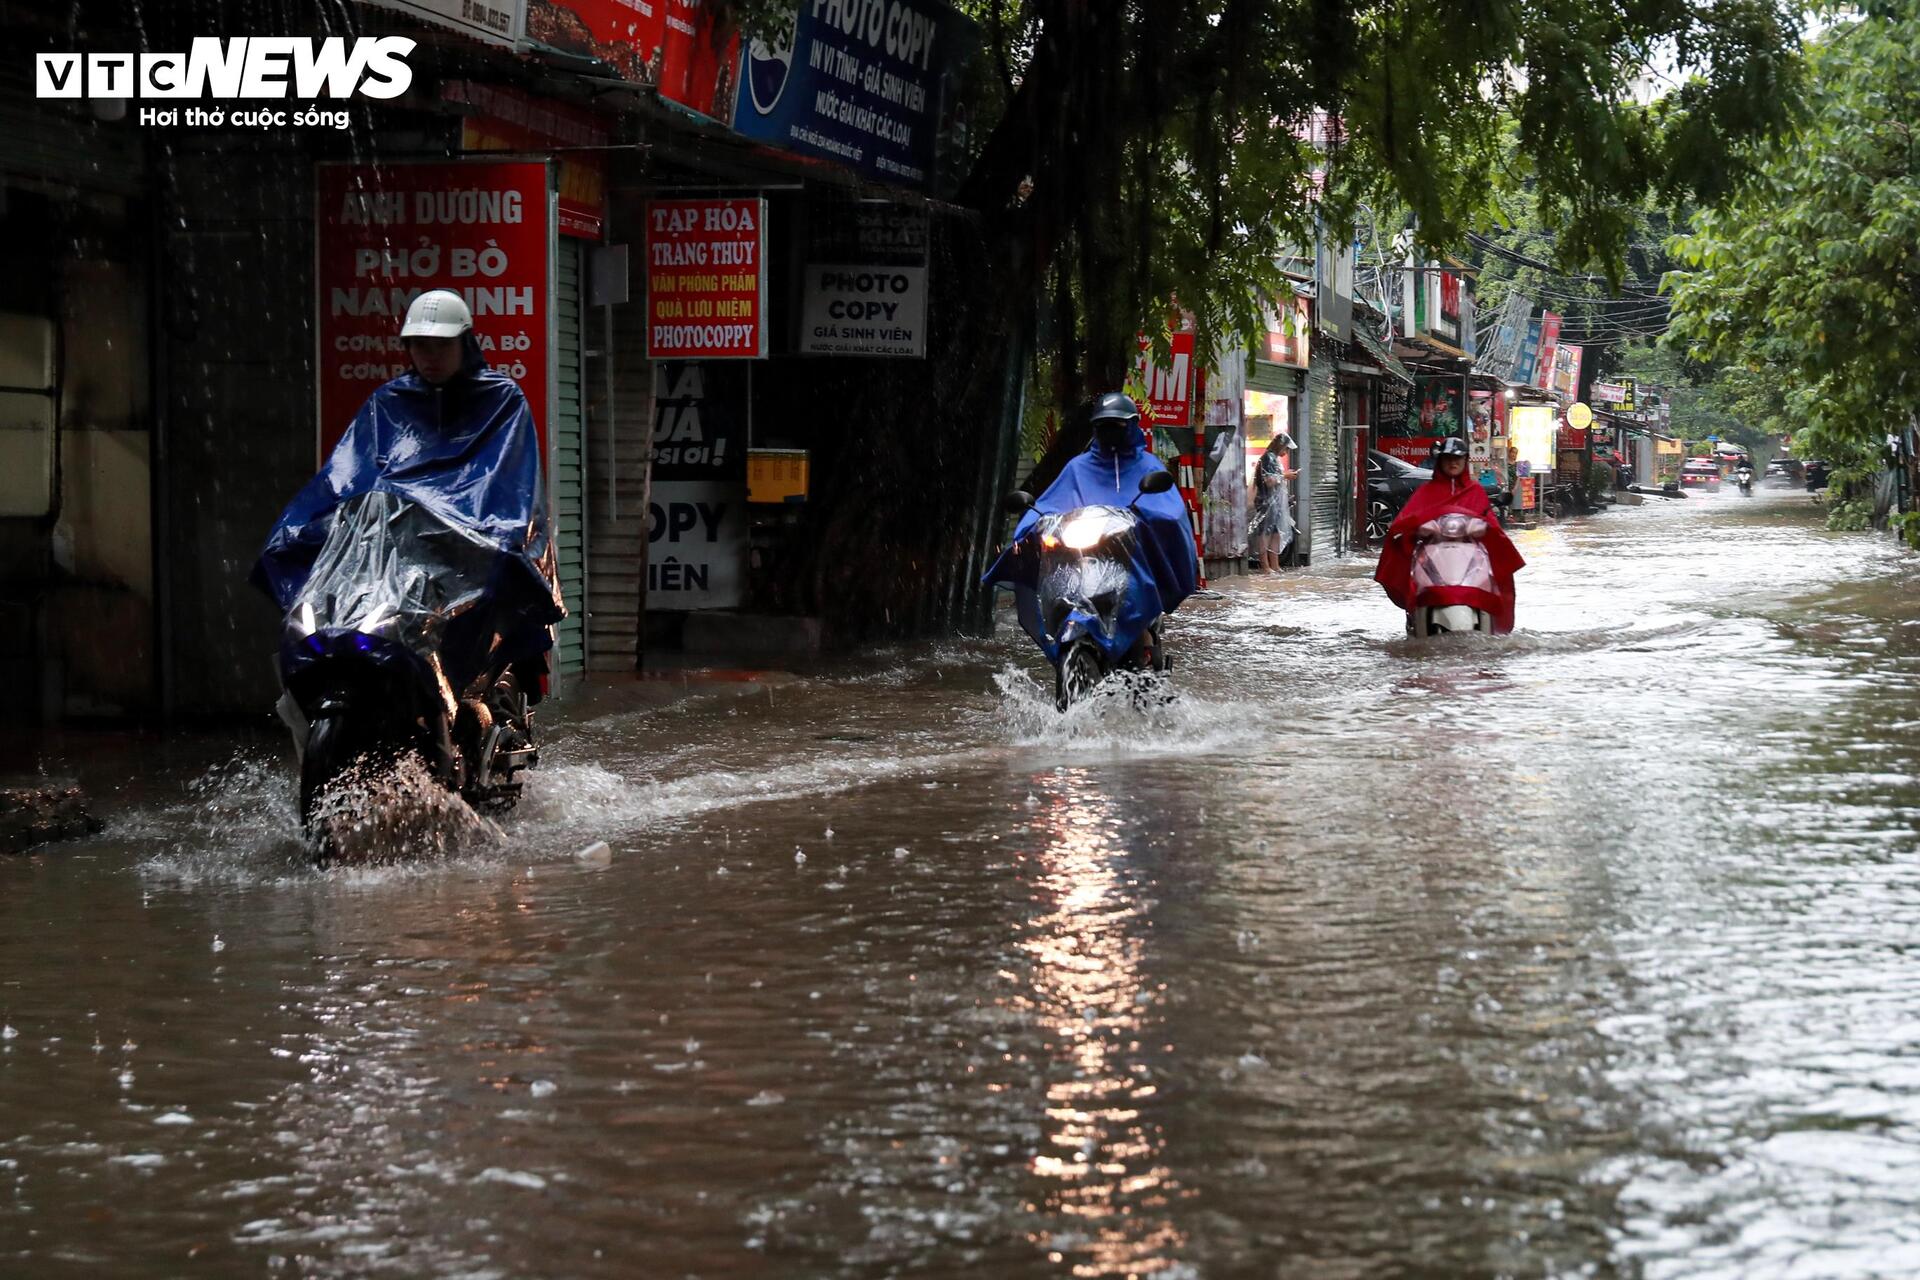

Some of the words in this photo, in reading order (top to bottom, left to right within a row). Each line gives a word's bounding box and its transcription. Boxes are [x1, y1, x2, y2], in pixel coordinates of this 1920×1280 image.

[886, 0, 936, 71] COPY
[809, 38, 824, 70] IN
[836, 45, 860, 86] TÍNH
[863, 60, 882, 96] GIÁ
[881, 72, 904, 105] SINH
[904, 78, 926, 113] VIÊN
[815, 89, 840, 120] NƯỚC
[855, 104, 878, 133] KHÁT
[876, 111, 893, 140] CÁC
[416, 186, 522, 225] DƯƠNG
[652, 208, 699, 238] TẠP
[704, 201, 755, 231] HÓA
[355, 235, 440, 277] PHỞ
[451, 239, 508, 277] BÒ
[652, 242, 708, 266] TRANG
[652, 272, 676, 292] VĂN
[679, 271, 718, 292] PHÒNG
[721, 268, 756, 291] PHẨM
[821, 272, 908, 294] PHOTO
[656, 297, 684, 320] QUÀ
[687, 300, 712, 318] LƯU
[716, 297, 752, 321] NIỆM
[829, 300, 899, 322] COPY
[334, 334, 385, 352] CƠM
[501, 331, 531, 351] BÒ
[653, 324, 754, 349] PHOTOCOPPY
[814, 324, 838, 338] GIÁ
[842, 327, 875, 339] SINH
[880, 326, 912, 341] VIÊN
[339, 362, 387, 380] CƠM
